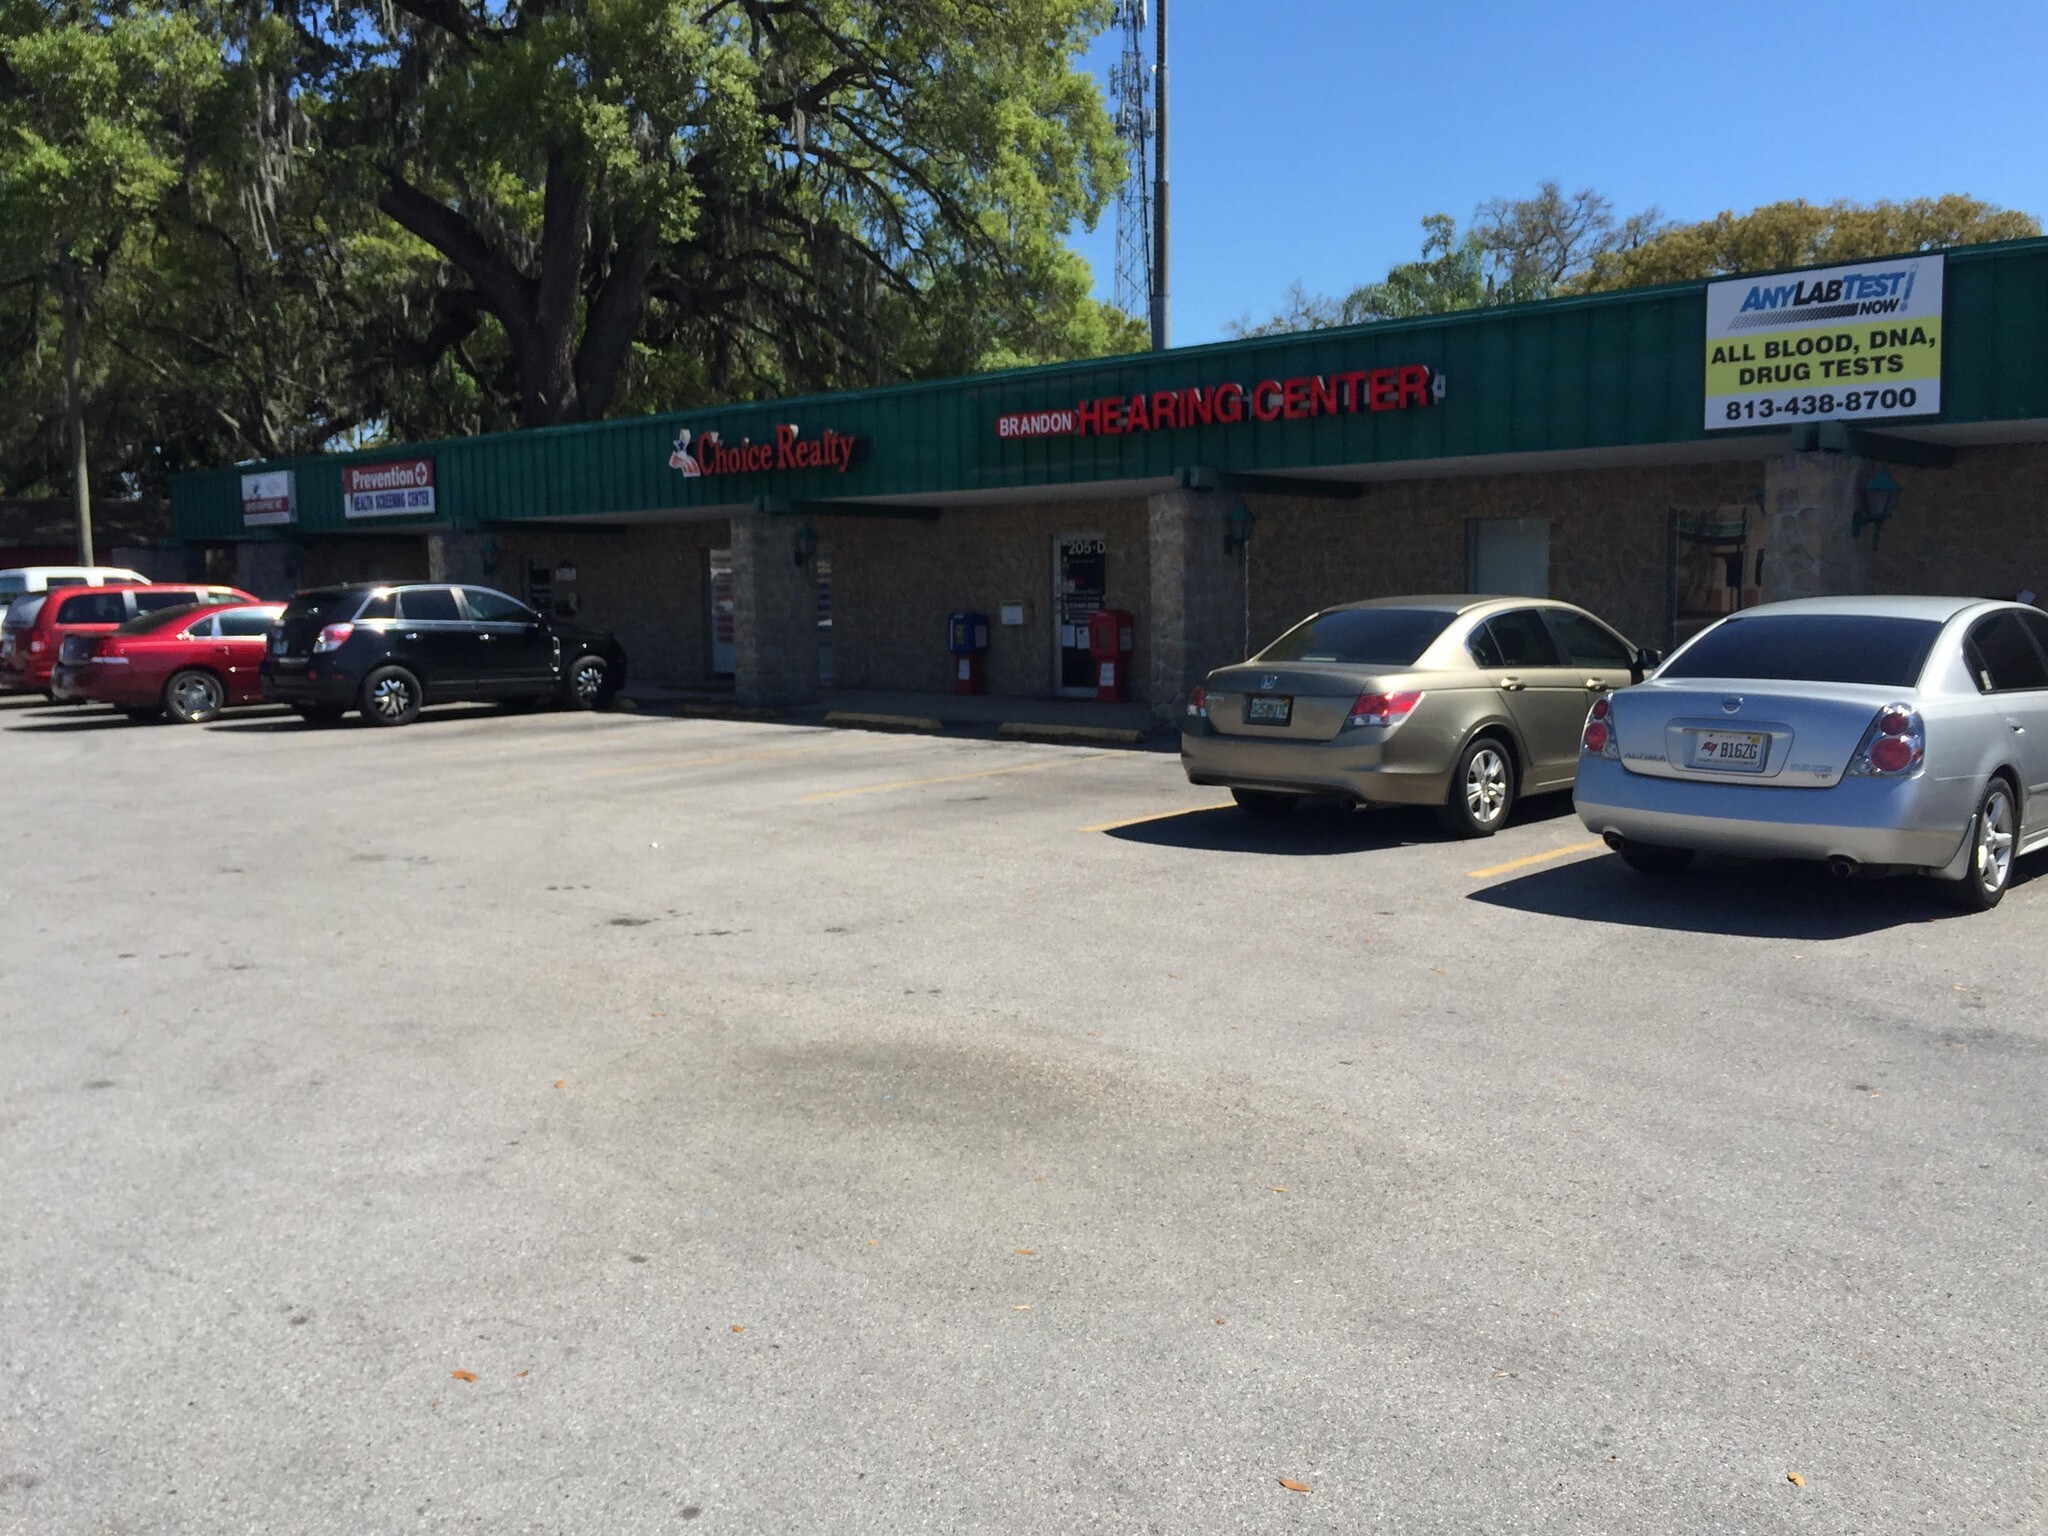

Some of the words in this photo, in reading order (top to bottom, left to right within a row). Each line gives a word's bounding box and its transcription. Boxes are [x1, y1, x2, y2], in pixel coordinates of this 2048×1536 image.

[1711, 344, 1755, 364] ALL
[1765, 333, 1859, 360] BLOOD,
[1870, 326, 1935, 348] DNA,
[1739, 362, 1810, 385] DRUG
[1819, 353, 1903, 378] TESTS
[999, 411, 1072, 437] BRANDON
[1078, 383, 1243, 437] HEARING
[1254, 364, 1430, 421] CENTER
[1726, 387, 1917, 420] 813-438-8700
[698, 431, 773, 475] Choice
[775, 424, 855, 473] Realty
[352, 465, 414, 490] Prevention
